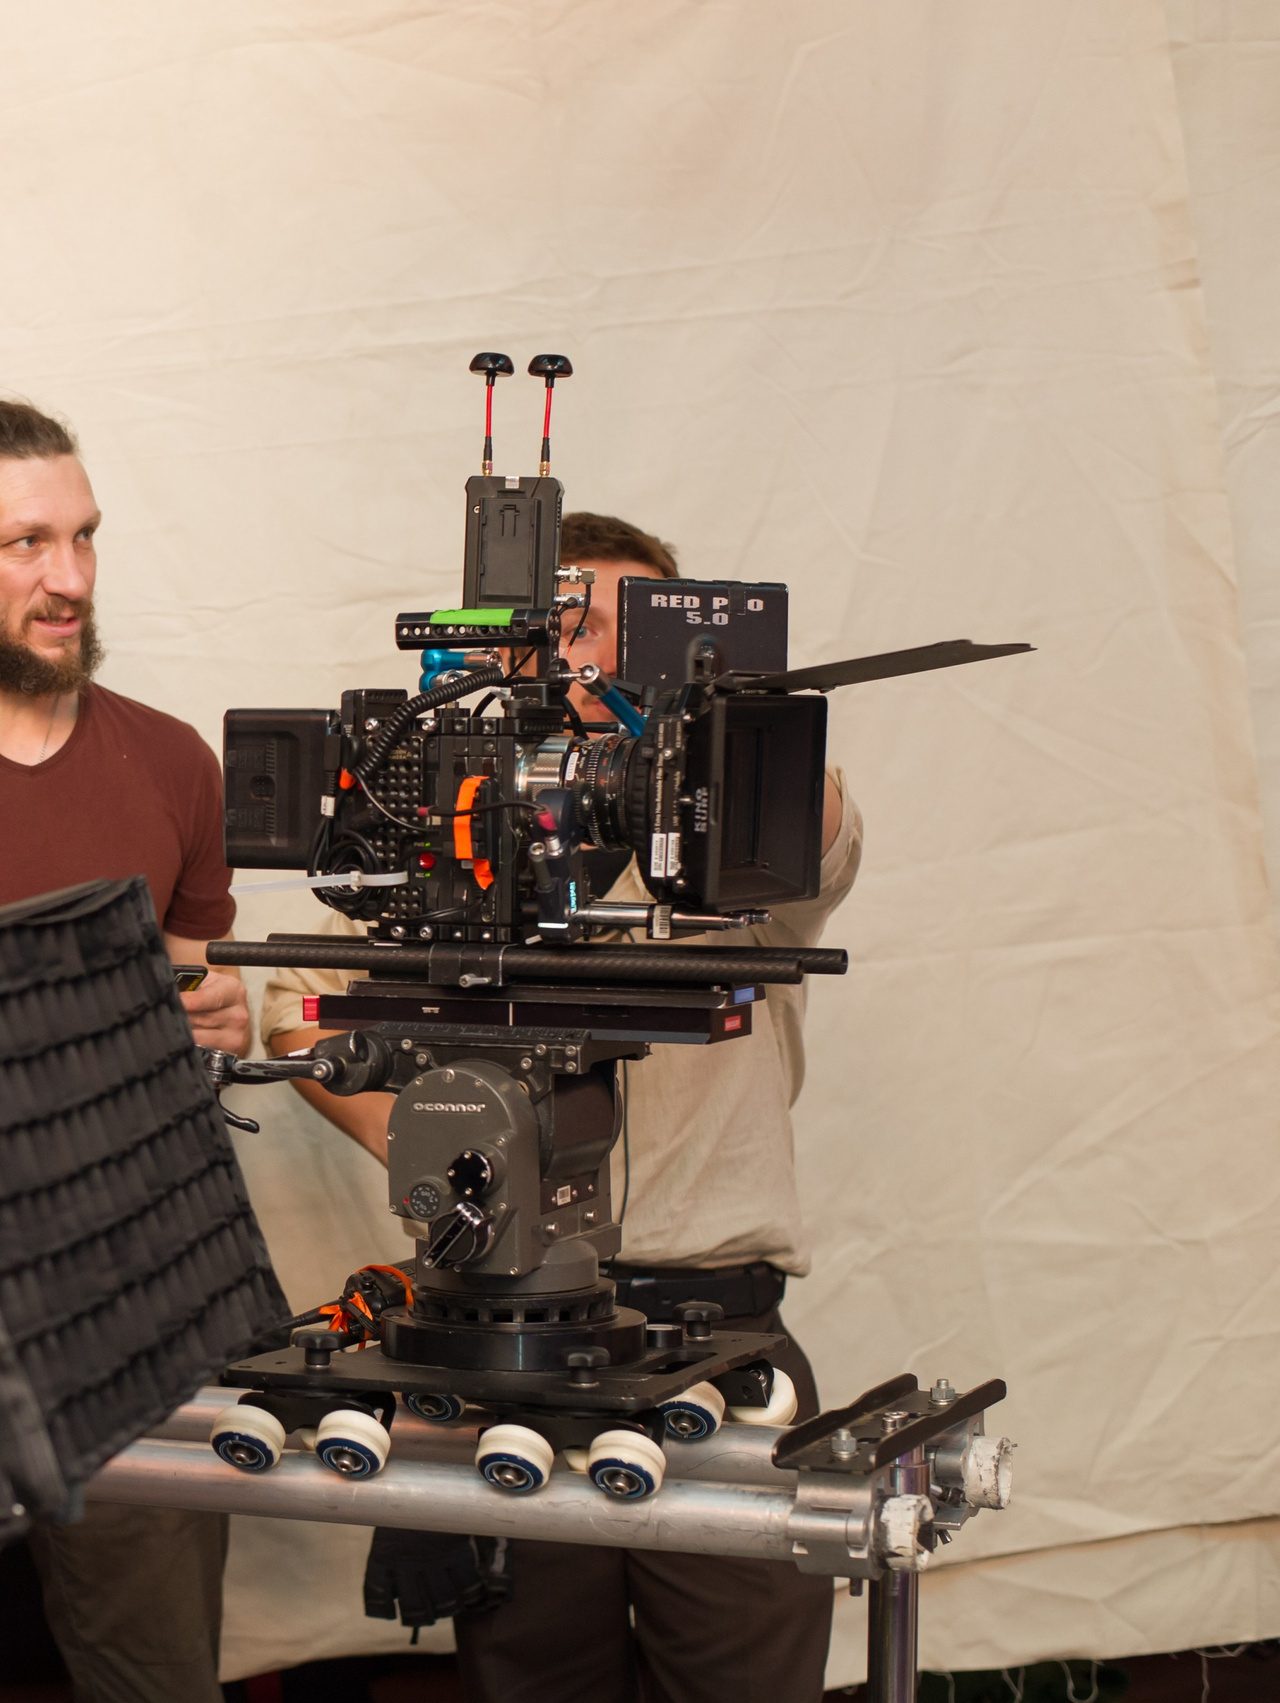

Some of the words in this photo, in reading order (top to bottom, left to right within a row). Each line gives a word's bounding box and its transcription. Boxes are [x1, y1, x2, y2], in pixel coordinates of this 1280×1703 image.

[651, 594, 700, 609] RED
[712, 596, 764, 612] PO
[685, 611, 729, 626] 5.0
[413, 1102, 486, 1113] oconnor
